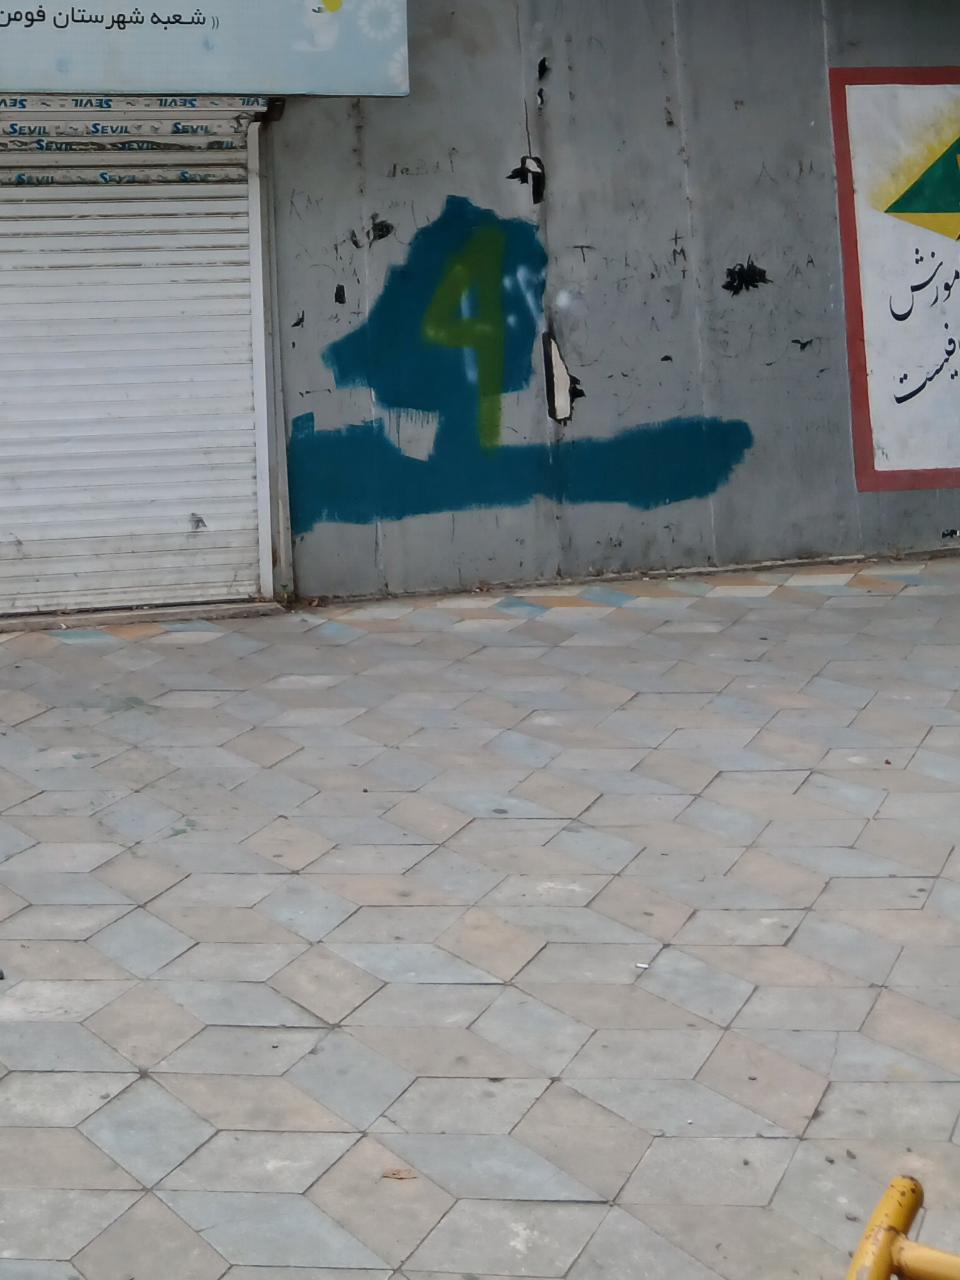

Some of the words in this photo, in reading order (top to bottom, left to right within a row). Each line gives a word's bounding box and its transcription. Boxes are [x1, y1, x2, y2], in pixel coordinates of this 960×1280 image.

[52, 6, 145, 31] شهرستان
[72, 98, 113, 109] SEVIL
[157, 98, 198, 109] SEVIL
[239, 97, 269, 108] EVIL
[9, 122, 49, 136] SEVIL
[91, 122, 130, 135] SEVIL
[889, 247, 960, 322] موزش
